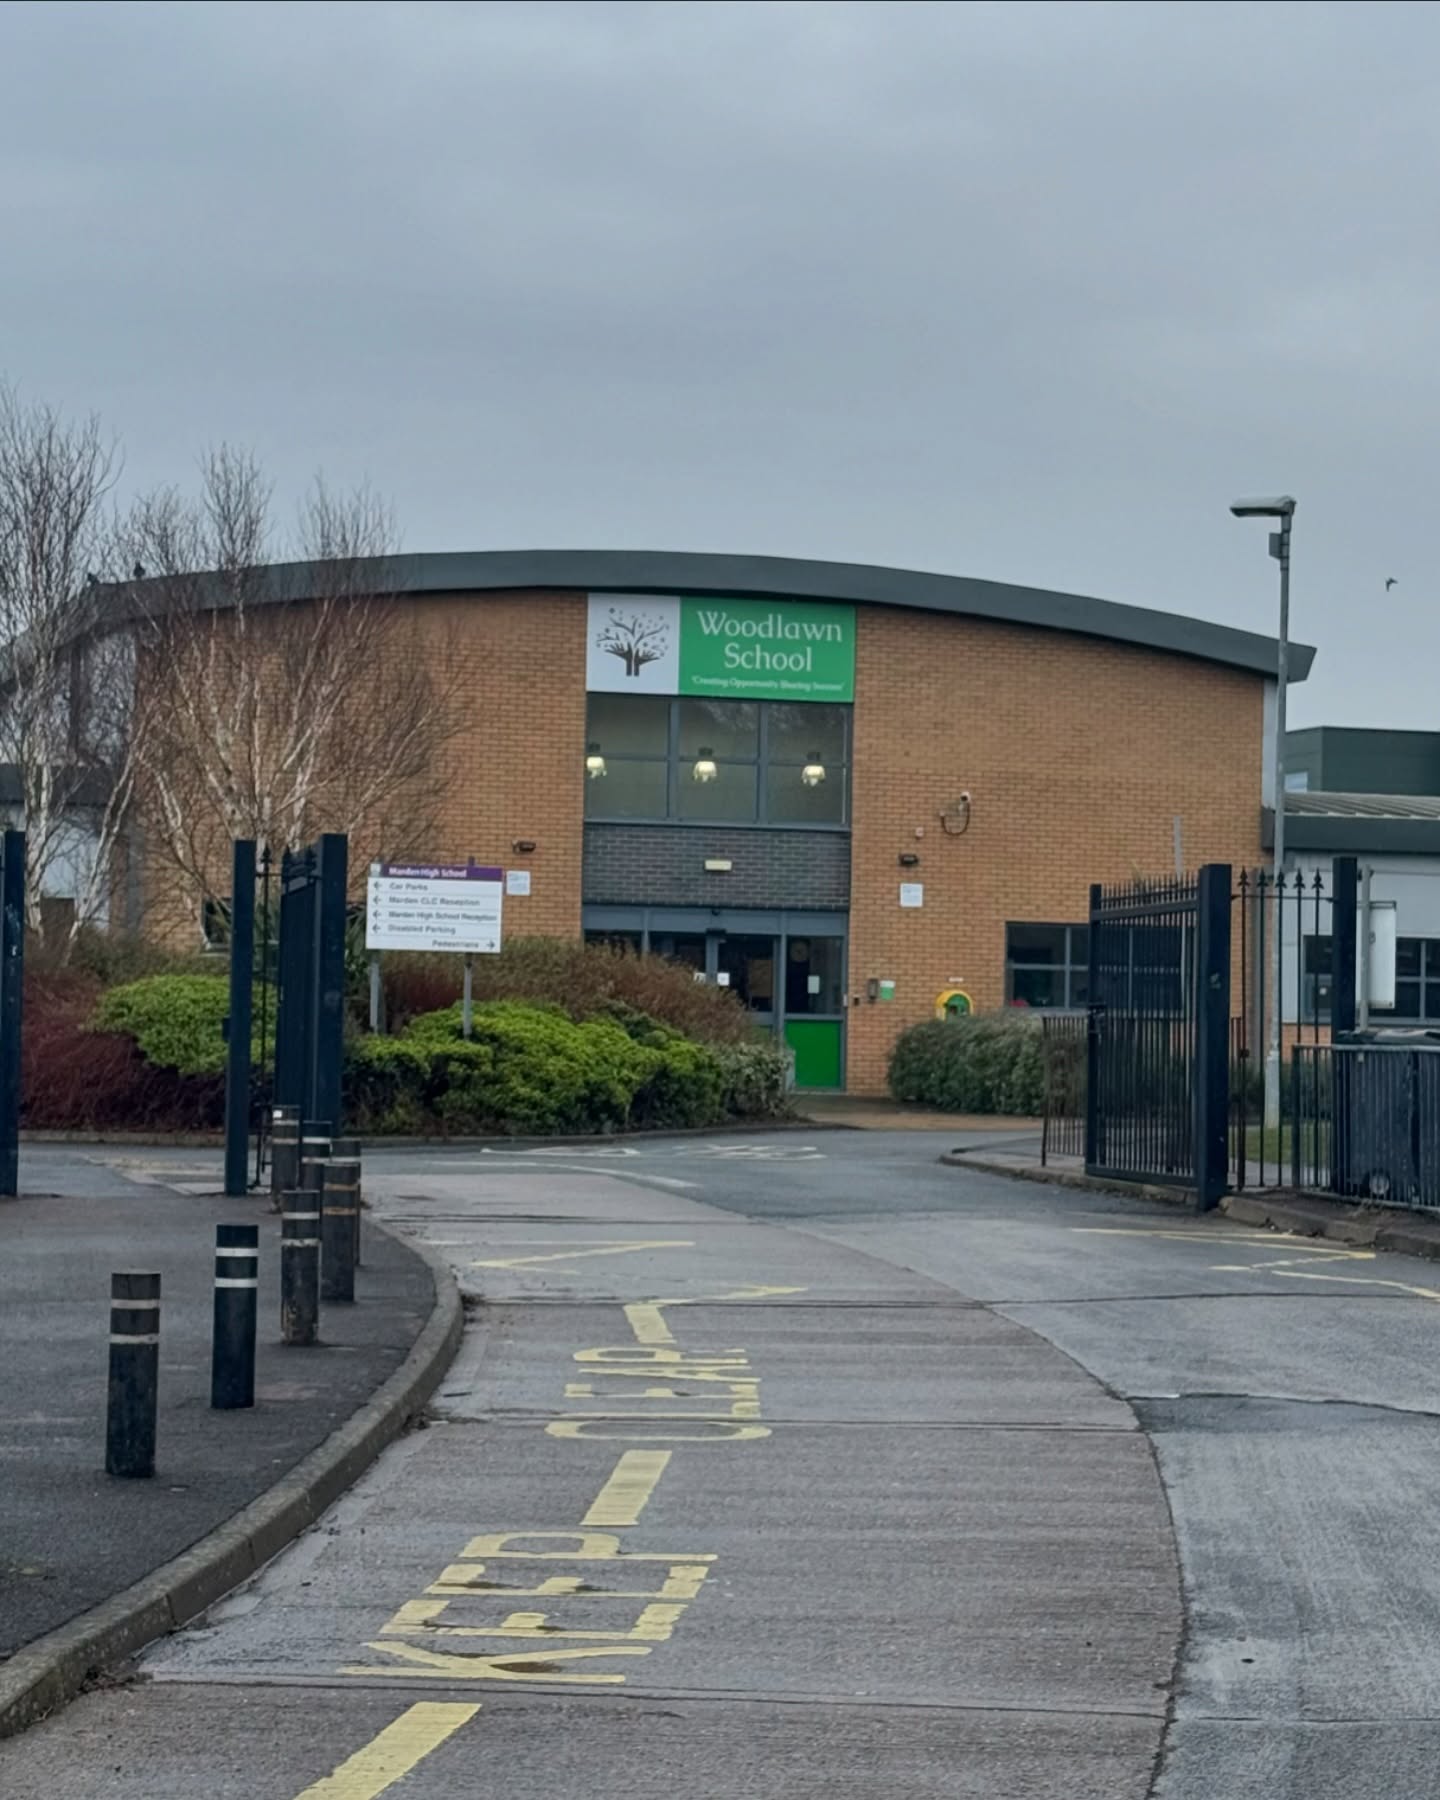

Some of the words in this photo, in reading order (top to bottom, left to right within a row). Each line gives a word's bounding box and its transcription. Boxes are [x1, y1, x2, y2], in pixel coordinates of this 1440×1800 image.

[697, 610, 843, 643] Woodlawn
[723, 642, 813, 672] School
[420, 867, 439, 879] High
[441, 869, 467, 878] School
[389, 882, 403, 890] Car
[405, 883, 428, 891] Parks
[388, 896, 419, 904] Marden
[440, 897, 480, 907] Reception
[416, 911, 433, 920] High
[461, 913, 497, 922] Reception
[387, 923, 423, 932] Disabled
[425, 924, 456, 935] Parking
[432, 939, 479, 948] Pedestrians
